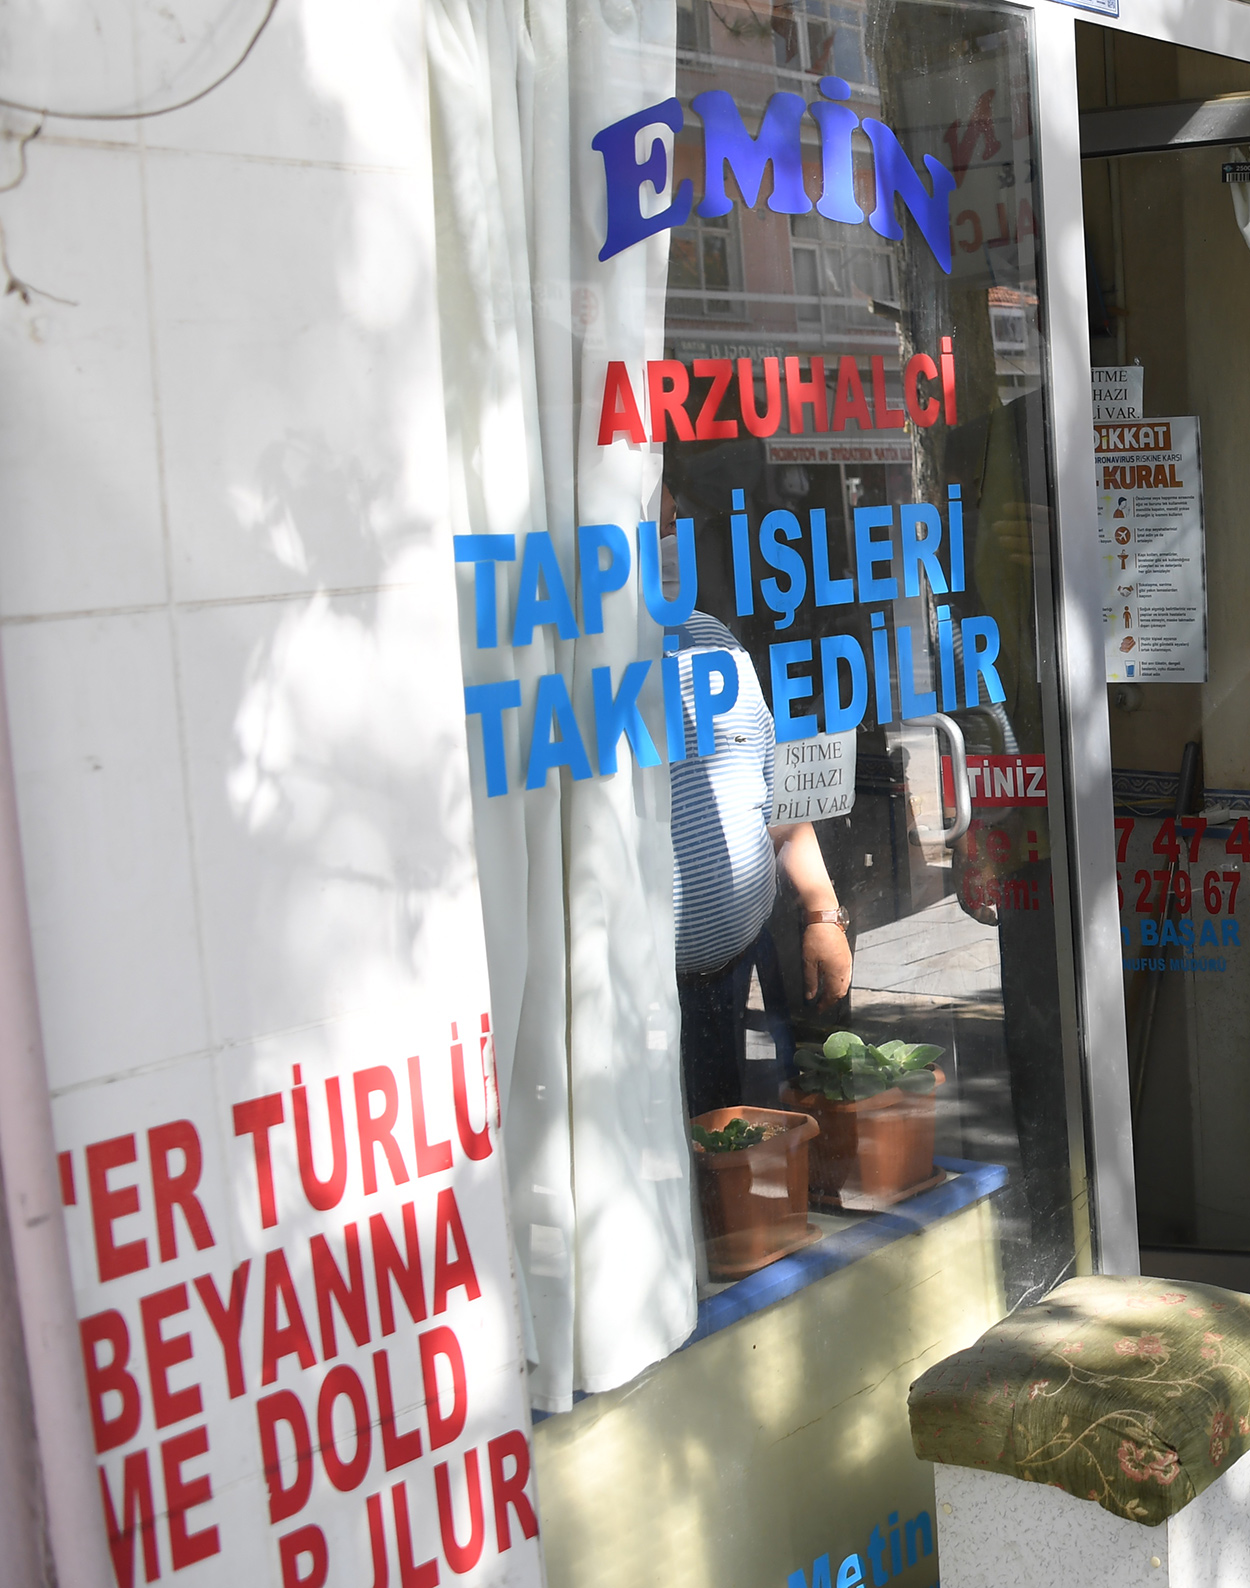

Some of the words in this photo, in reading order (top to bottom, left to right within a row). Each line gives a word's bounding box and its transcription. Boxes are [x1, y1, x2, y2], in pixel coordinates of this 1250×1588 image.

[592, 76, 956, 273] EMİN
[598, 337, 956, 446] ARZUHALCİ
[1105, 407, 1140, 419] VAR.
[1103, 464, 1183, 489] KURAL
[453, 518, 698, 649] TAPU
[732, 484, 965, 629] İŞLERİ
[464, 635, 738, 797] TAKİP
[769, 605, 1006, 742] EDİLİR
[785, 742, 842, 768] İŞİTME
[784, 768, 842, 792] CİHAZI
[776, 796, 811, 819] PİLİ
[817, 794, 850, 814] VAR.
[1152, 817, 1207, 863] 47
[1134, 869, 1192, 914] 279
[1203, 870, 1241, 915] 67
[1140, 918, 1241, 954] BAŞAR
[80, 1188, 481, 1454] BEYANNA
[257, 1325, 467, 1525] DOLD
